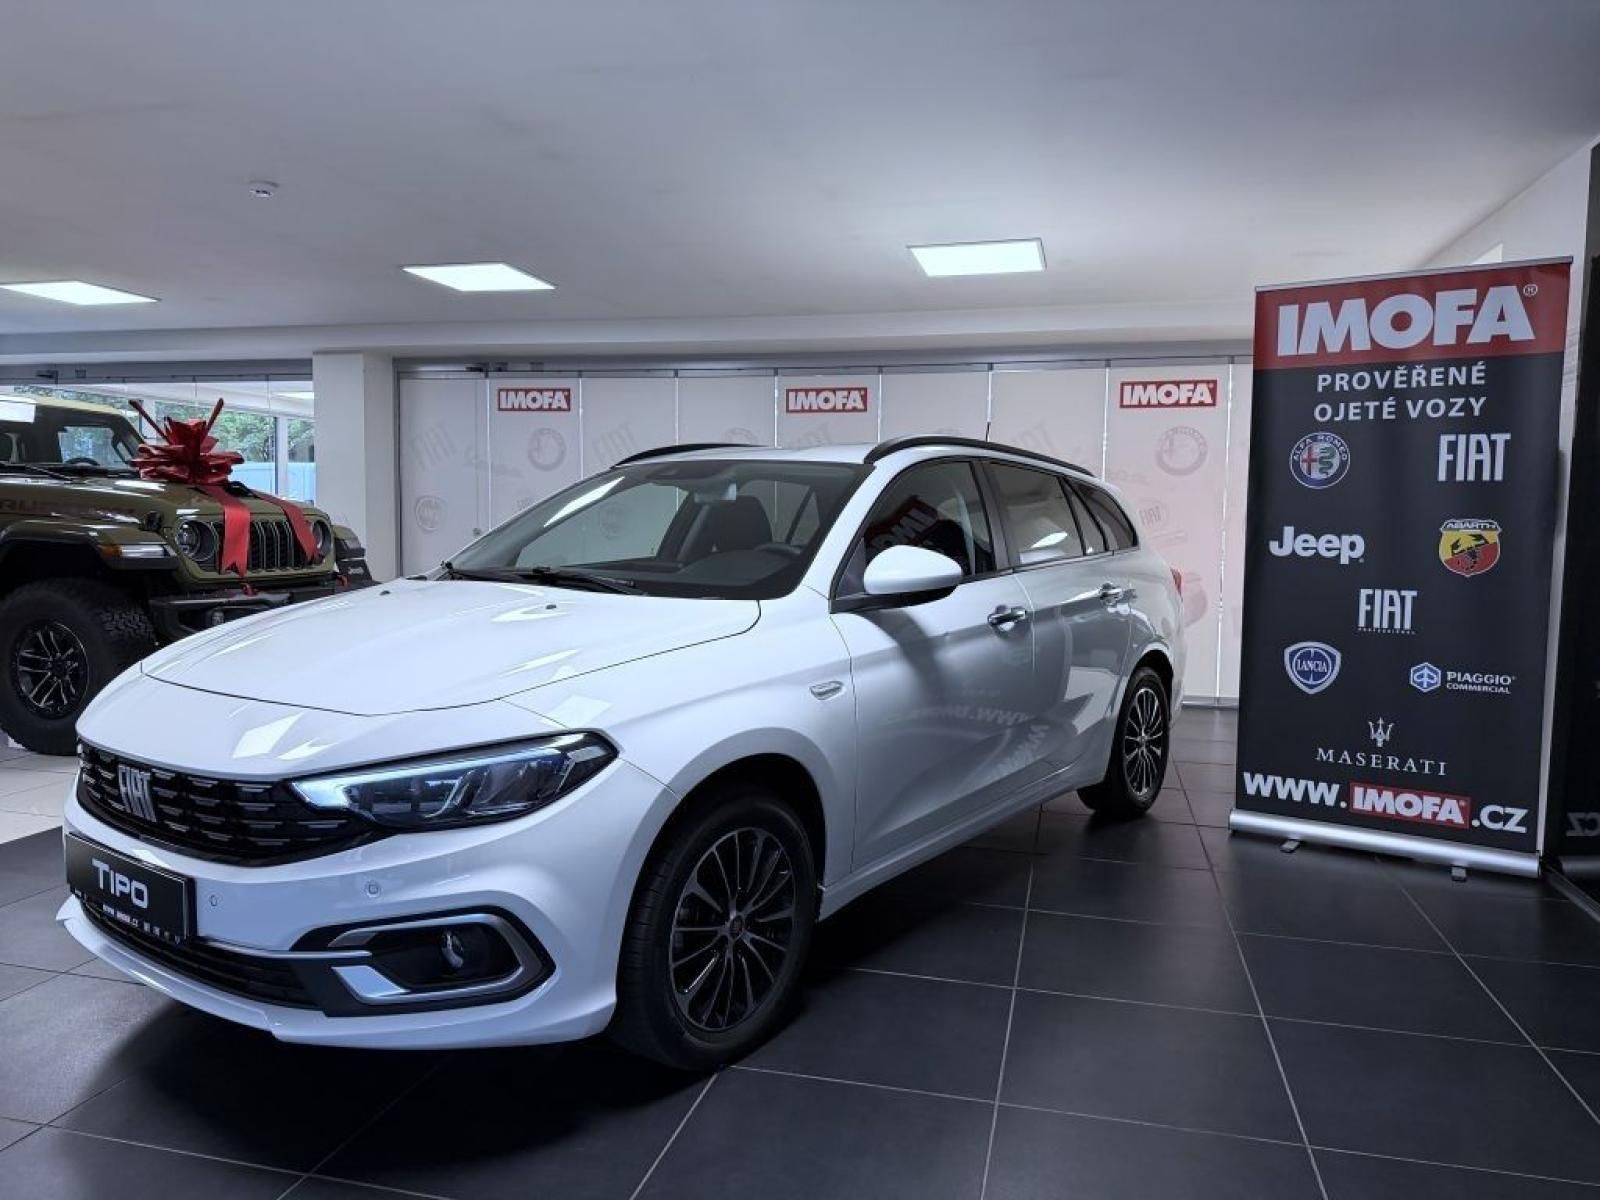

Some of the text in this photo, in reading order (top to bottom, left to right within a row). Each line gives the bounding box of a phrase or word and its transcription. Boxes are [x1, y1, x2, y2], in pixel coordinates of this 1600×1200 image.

[1277, 285, 1536, 357] IMOFA
[1316, 361, 1487, 393] PROVĚŘENÉ
[499, 391, 568, 410] IMOFA
[788, 390, 865, 411] IMOFA
[1122, 382, 1213, 406] IMOFA
[1313, 396, 1487, 423] OJETÉ VOZY
[1437, 433, 1511, 482] FIAT
[1269, 526, 1365, 565] Jeep
[1358, 588, 1418, 630] FIAT
[1296, 658, 1328, 673] LANCIA
[1446, 671, 1512, 686] PIAGGIO
[1446, 682, 1512, 695] COMMERCIAL
[1316, 747, 1449, 776] MASERATI
[118, 764, 157, 822] FIAT
[92, 857, 149, 910] TIPO
